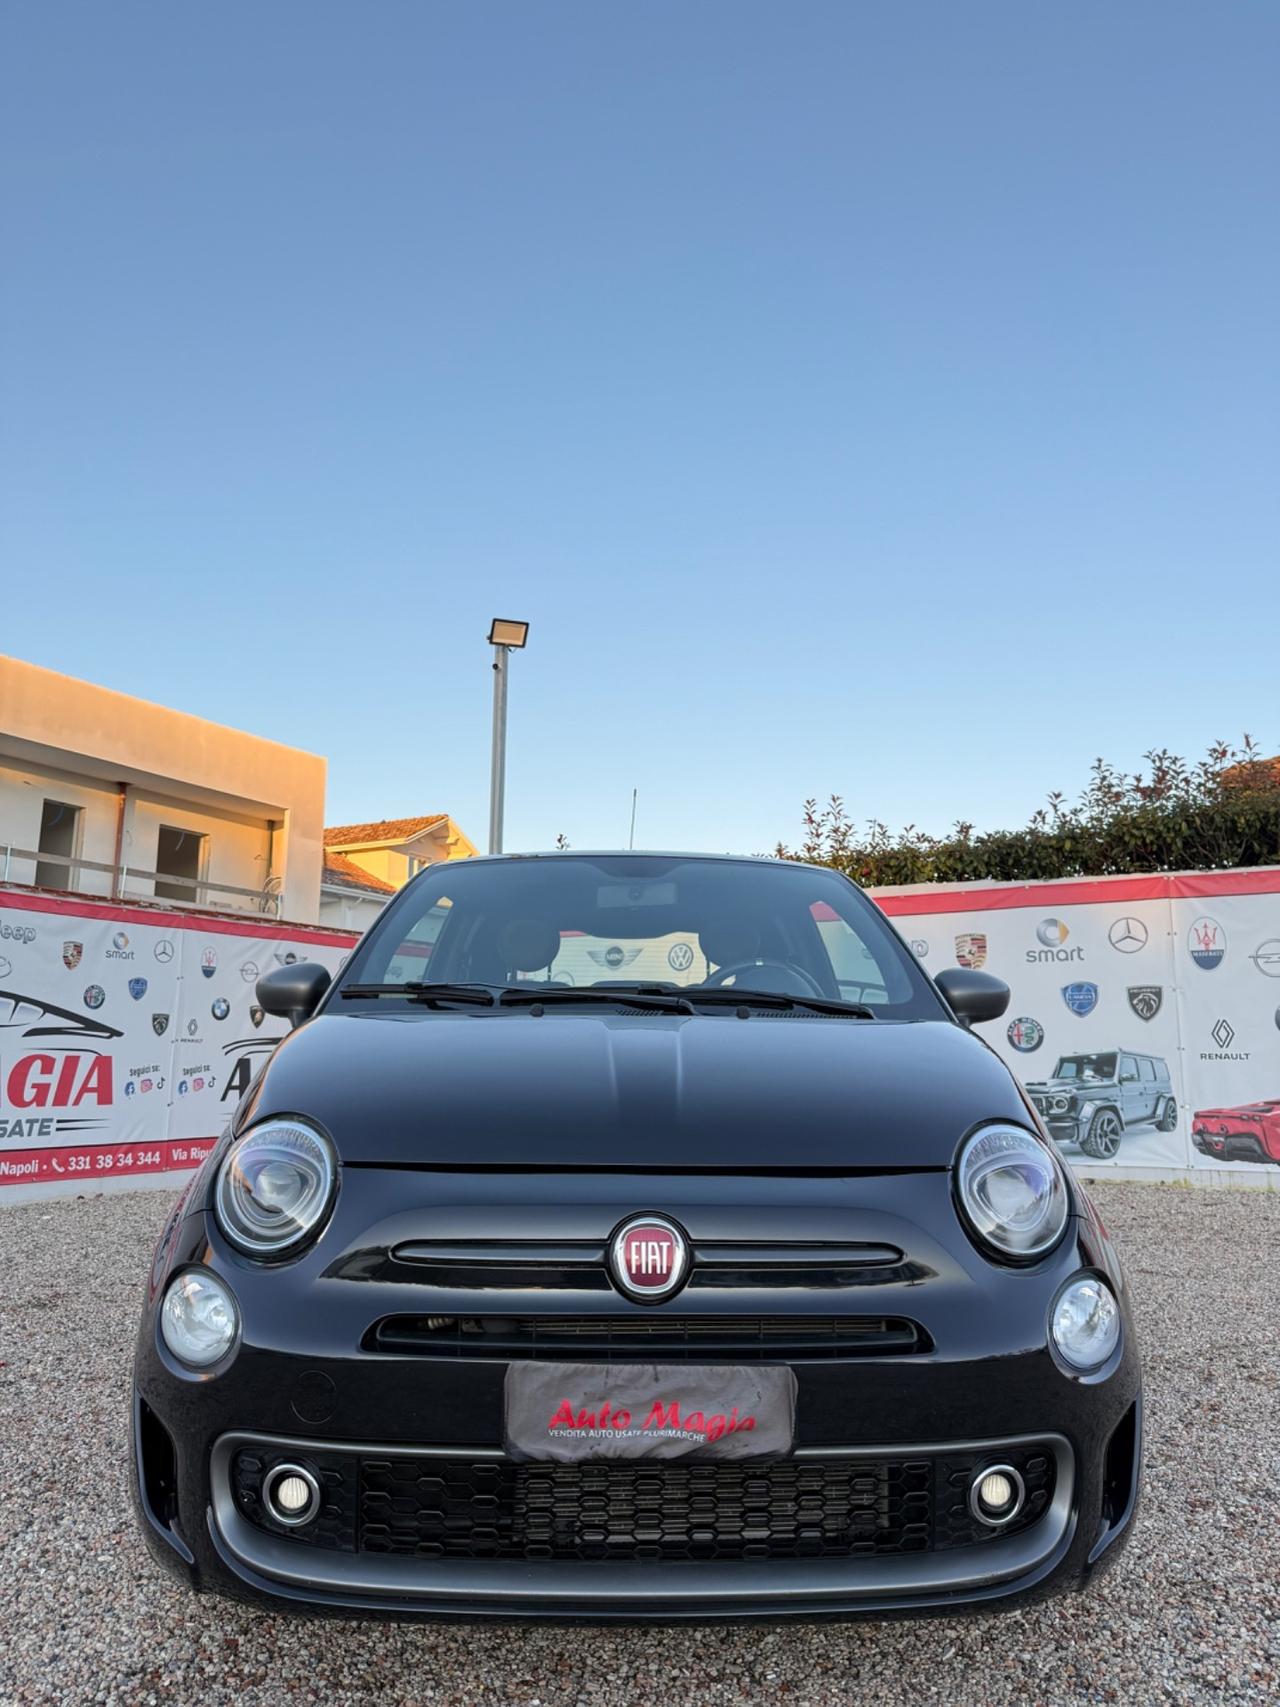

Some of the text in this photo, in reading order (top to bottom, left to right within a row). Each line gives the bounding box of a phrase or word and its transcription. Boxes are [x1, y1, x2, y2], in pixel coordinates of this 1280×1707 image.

[0, 921, 36, 944] eep
[105, 950, 135, 960] smart
[1026, 946, 1085, 964] smart
[1200, 1053, 1250, 1061] RENAULT
[0, 1054, 113, 1108] GIA
[0, 1151, 160, 1176] Napoli 331 38 34 344
[172, 1148, 187, 1160] Via
[631, 1241, 671, 1275] FIAT
[548, 1398, 756, 1442] Auto Magia
[548, 1429, 587, 1438] VENDITA
[589, 1430, 614, 1438] AUTO
